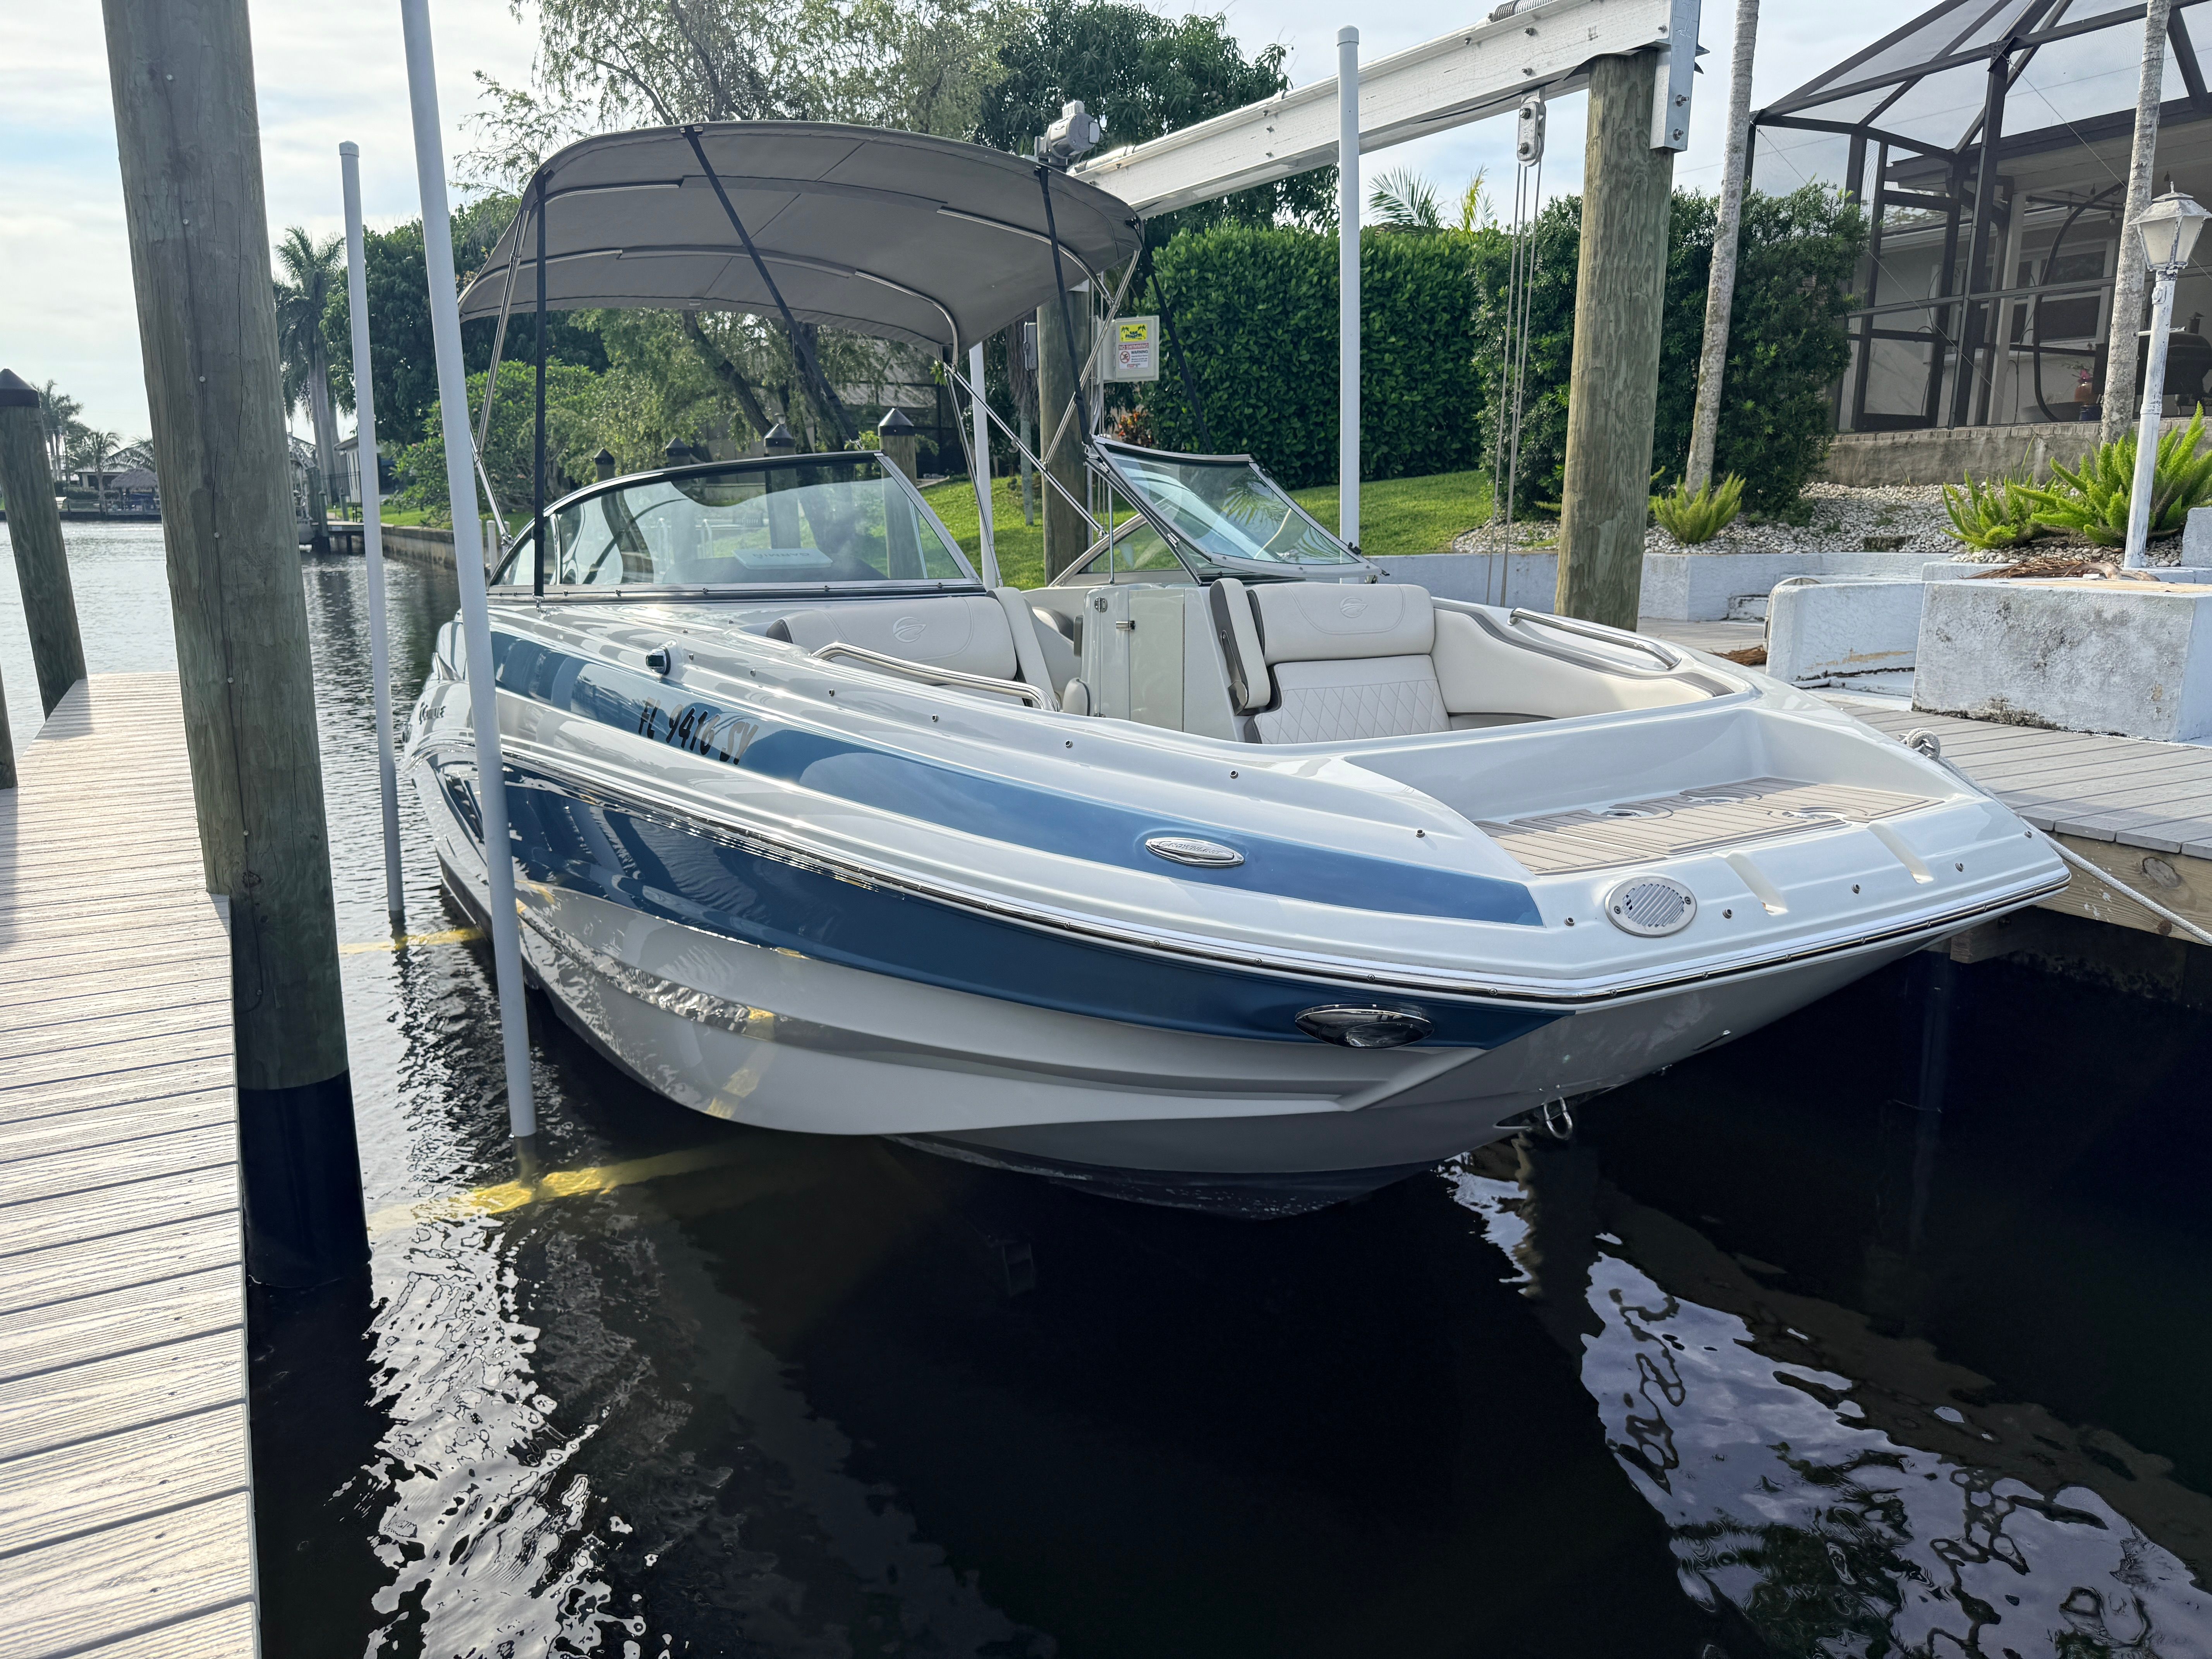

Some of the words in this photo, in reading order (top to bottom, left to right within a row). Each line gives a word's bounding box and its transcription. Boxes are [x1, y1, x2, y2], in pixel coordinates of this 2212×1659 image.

[638, 697, 661, 739] FL
[666, 704, 721, 756] 9416
[719, 721, 759, 765] SY
[1159, 841, 1223, 855] CROWNLINE
